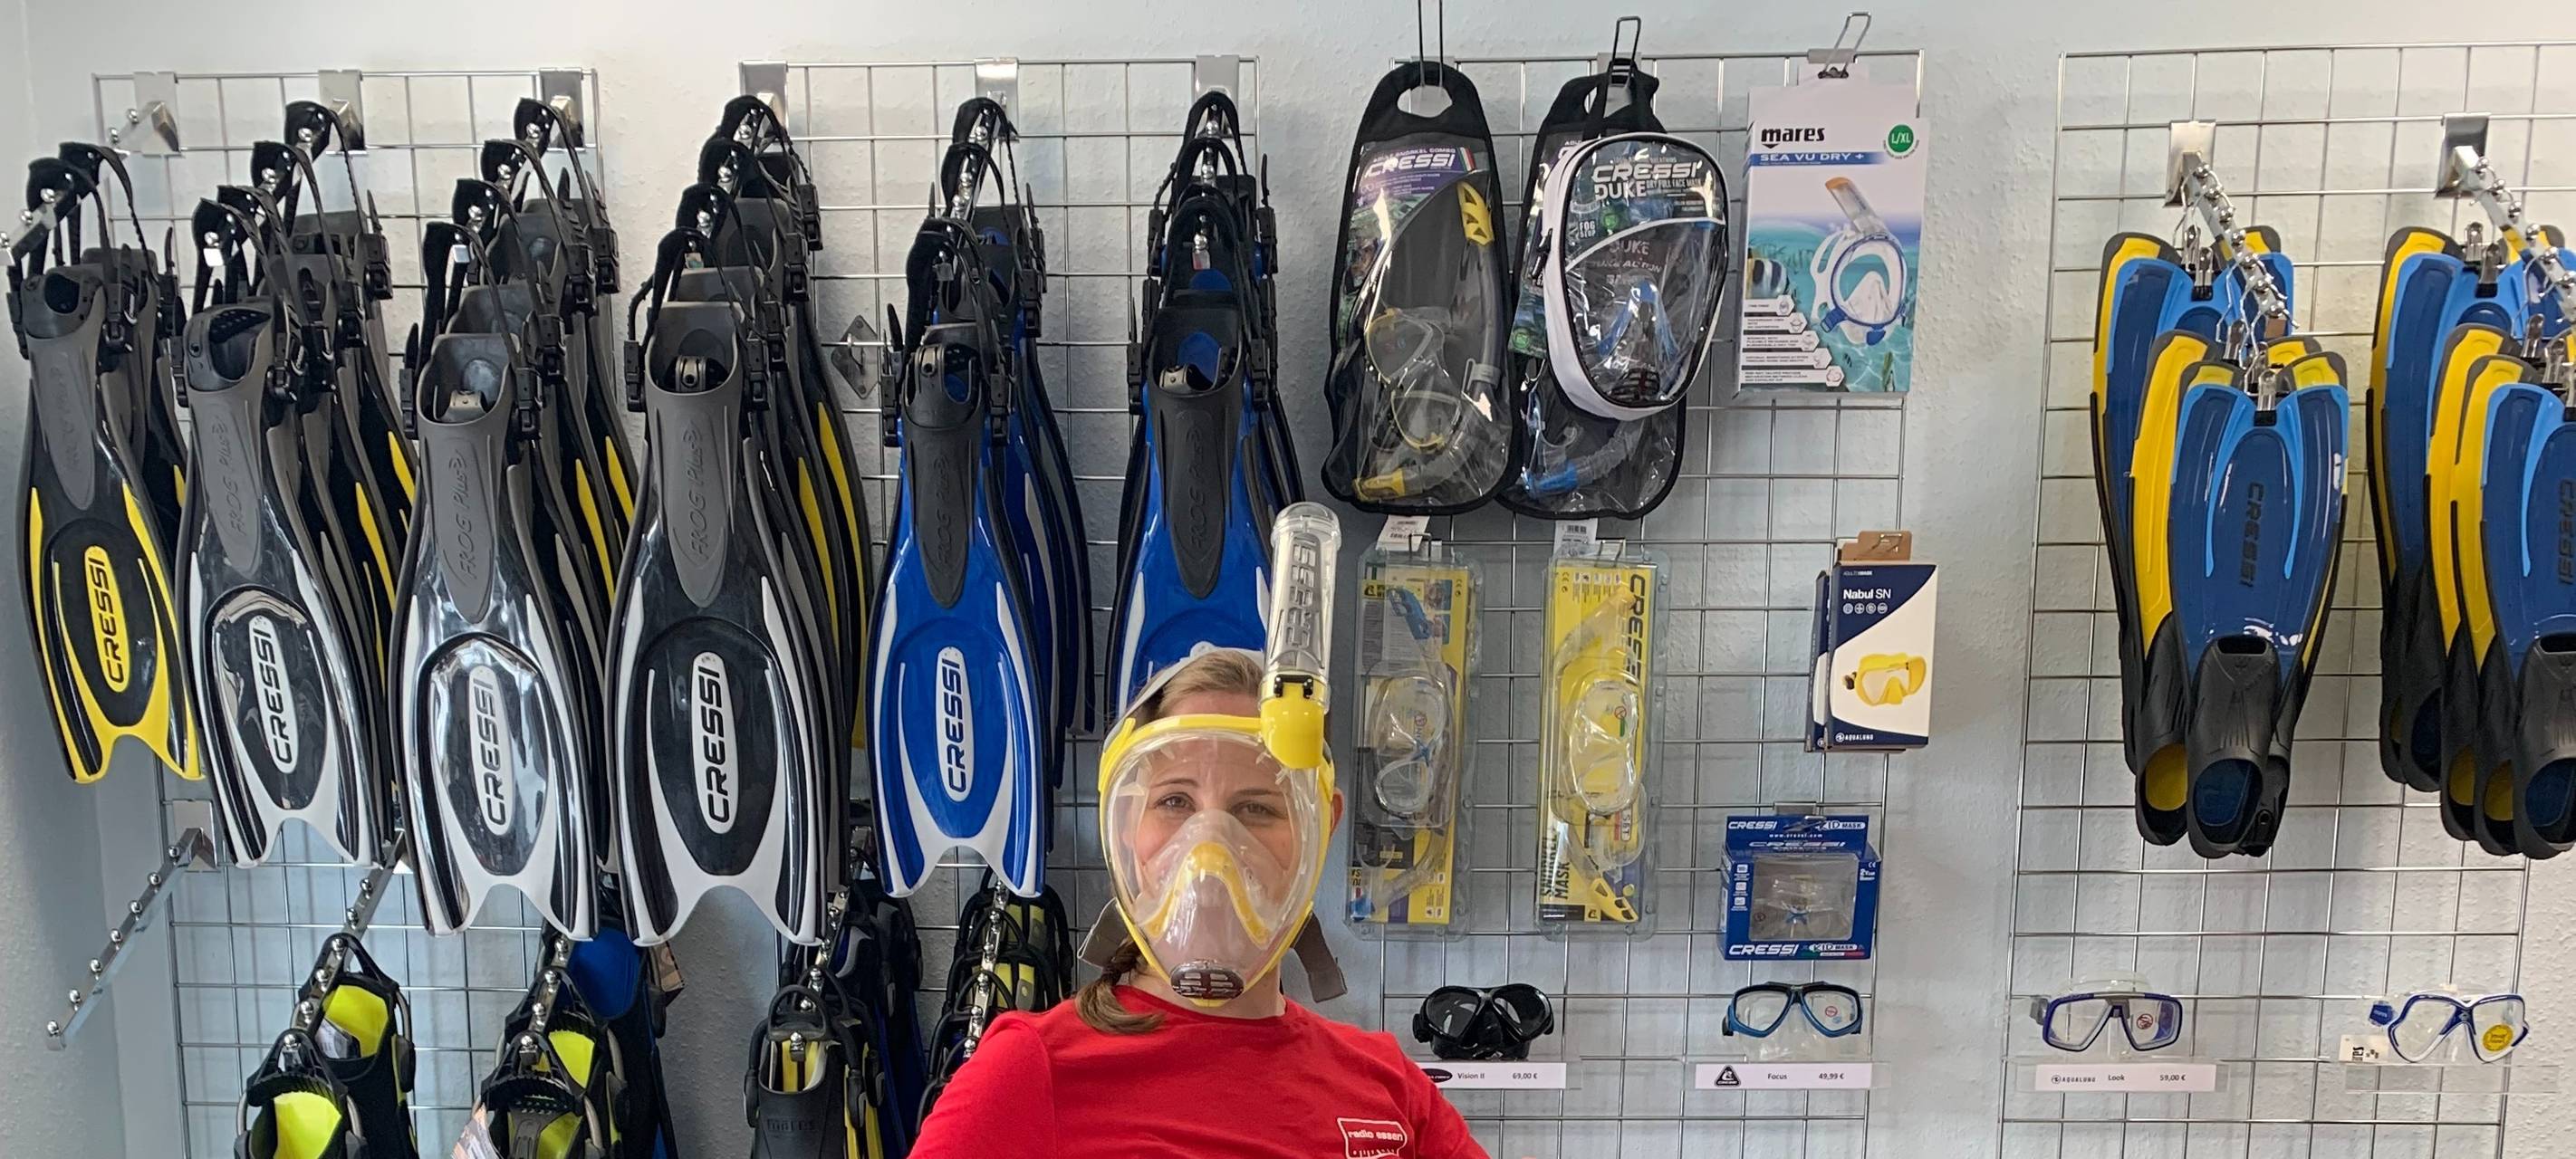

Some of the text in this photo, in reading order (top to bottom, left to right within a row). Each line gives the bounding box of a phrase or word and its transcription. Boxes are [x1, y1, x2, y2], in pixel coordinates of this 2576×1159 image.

[1761, 128, 1825, 142] mares
[1891, 133, 1911, 144] L/XL
[1760, 153, 1790, 161] SEA
[1794, 153, 1815, 161] VU
[1366, 153, 1456, 177] CRESSI
[1591, 162, 1699, 182] CRESSI
[1595, 181, 1647, 200] DUKE
[458, 516, 478, 580] FROG
[1843, 589, 1891, 599] Nabul SN
[88, 557, 123, 684] CRESSI
[254, 628, 293, 766] CRESSI
[942, 656, 967, 793] CRESSI
[698, 665, 730, 823] CRESSI
[473, 679, 506, 827] CRESSI
[1728, 820, 1777, 830] CRESSI
[1728, 944, 1799, 955] CRESSI
[1513, 1072, 1532, 1080] 69,00
[1818, 1073, 1839, 1081] 49,99
[2159, 1074, 2179, 1082] 59,00
[1348, 1129, 1403, 1141] radio essen
